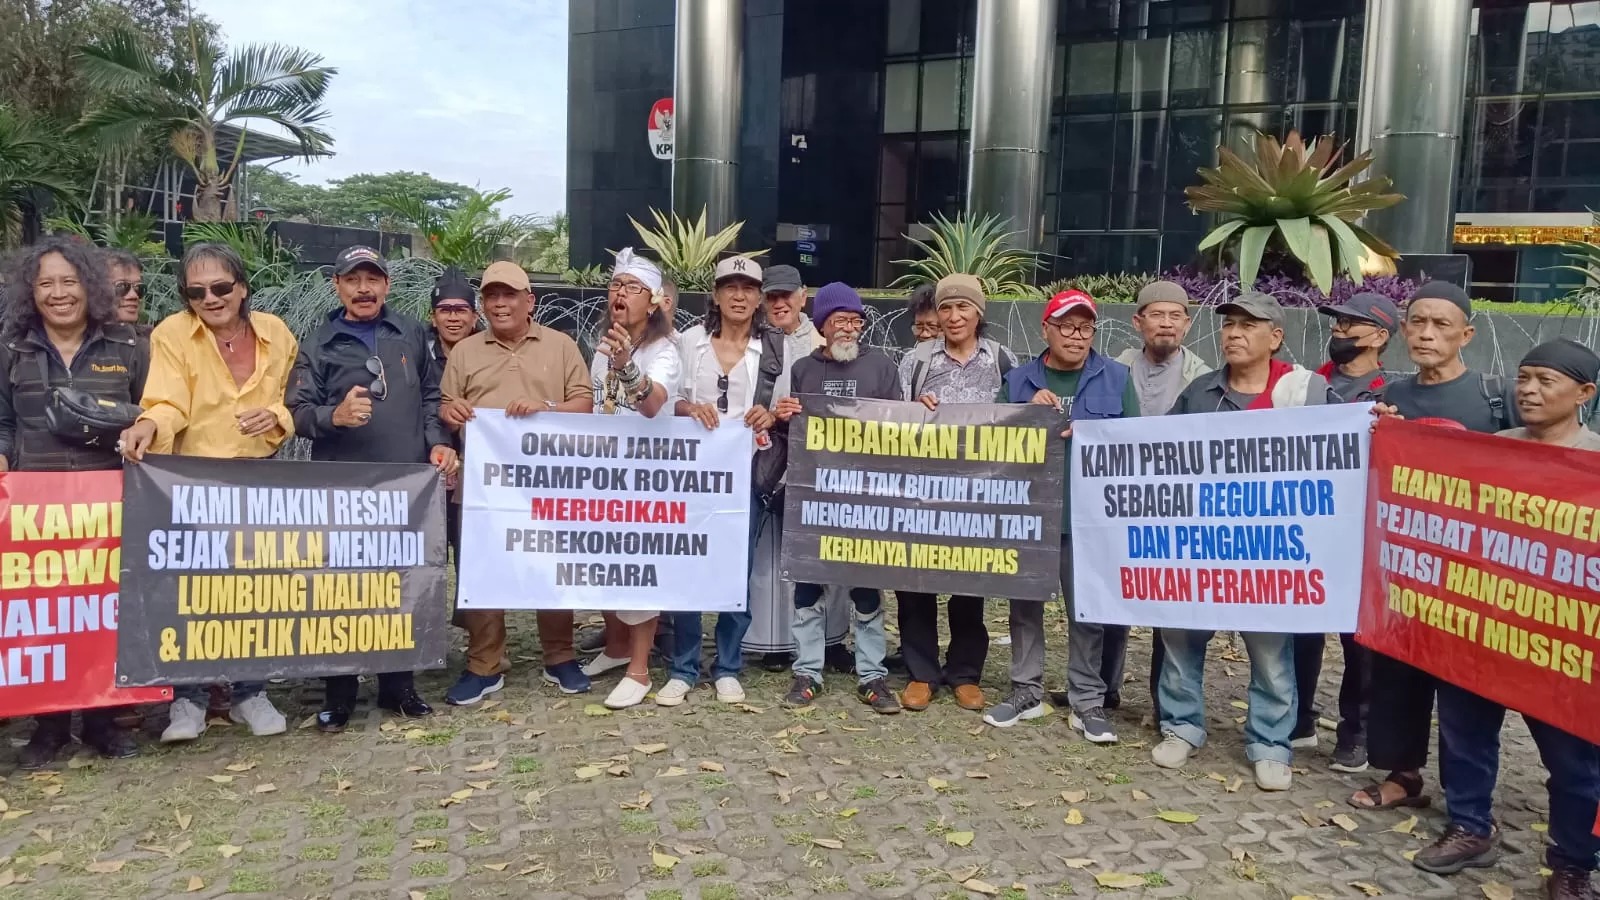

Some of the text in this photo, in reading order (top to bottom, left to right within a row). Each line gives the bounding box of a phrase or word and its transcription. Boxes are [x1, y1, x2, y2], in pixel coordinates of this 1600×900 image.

[656, 144, 673, 155] KP
[521, 432, 701, 461] OKNUM JAHAT
[806, 416, 1047, 464] BUBARKAN LMKN
[1081, 432, 1361, 478] KAMI PERLU PEMERINTAH
[483, 462, 733, 494] PERAMPOK ROYALTI
[815, 468, 1031, 505] KAMI TAK BUTUH PIHAK
[1391, 465, 1472, 511] HANYA
[171, 485, 409, 526] KAMI MAKIN RESAH
[531, 497, 686, 524] MERUGIKAN
[1103, 479, 1335, 518] SEBAGAI REGULATOR
[10, 502, 122, 541] KAMI
[801, 501, 1042, 541] MENGAKU PAHLAWAN TAPI
[1376, 500, 1476, 553] PEJABAT
[1481, 527, 1548, 577] YANG
[148, 530, 425, 570] SEJAK L.M.K.N MENJADI
[505, 528, 708, 556] PEREKONOMIAN
[819, 535, 1019, 575] KERJANYA MERAMPAS
[1127, 524, 1310, 565] DAN PENGAWAS,
[178, 572, 401, 615] LUMBUNG MALING
[556, 562, 658, 587] NEGARA
[1120, 566, 1326, 605] BUKAN PERAMPAS
[1379, 540, 1600, 639] ATASI HANCURNY
[0, 592, 119, 638] ALING
[1388, 582, 1593, 685] ROYALTI MUSISI
[159, 614, 415, 662] & KONFLIK NASIONAL
[0, 644, 66, 687] LTI
